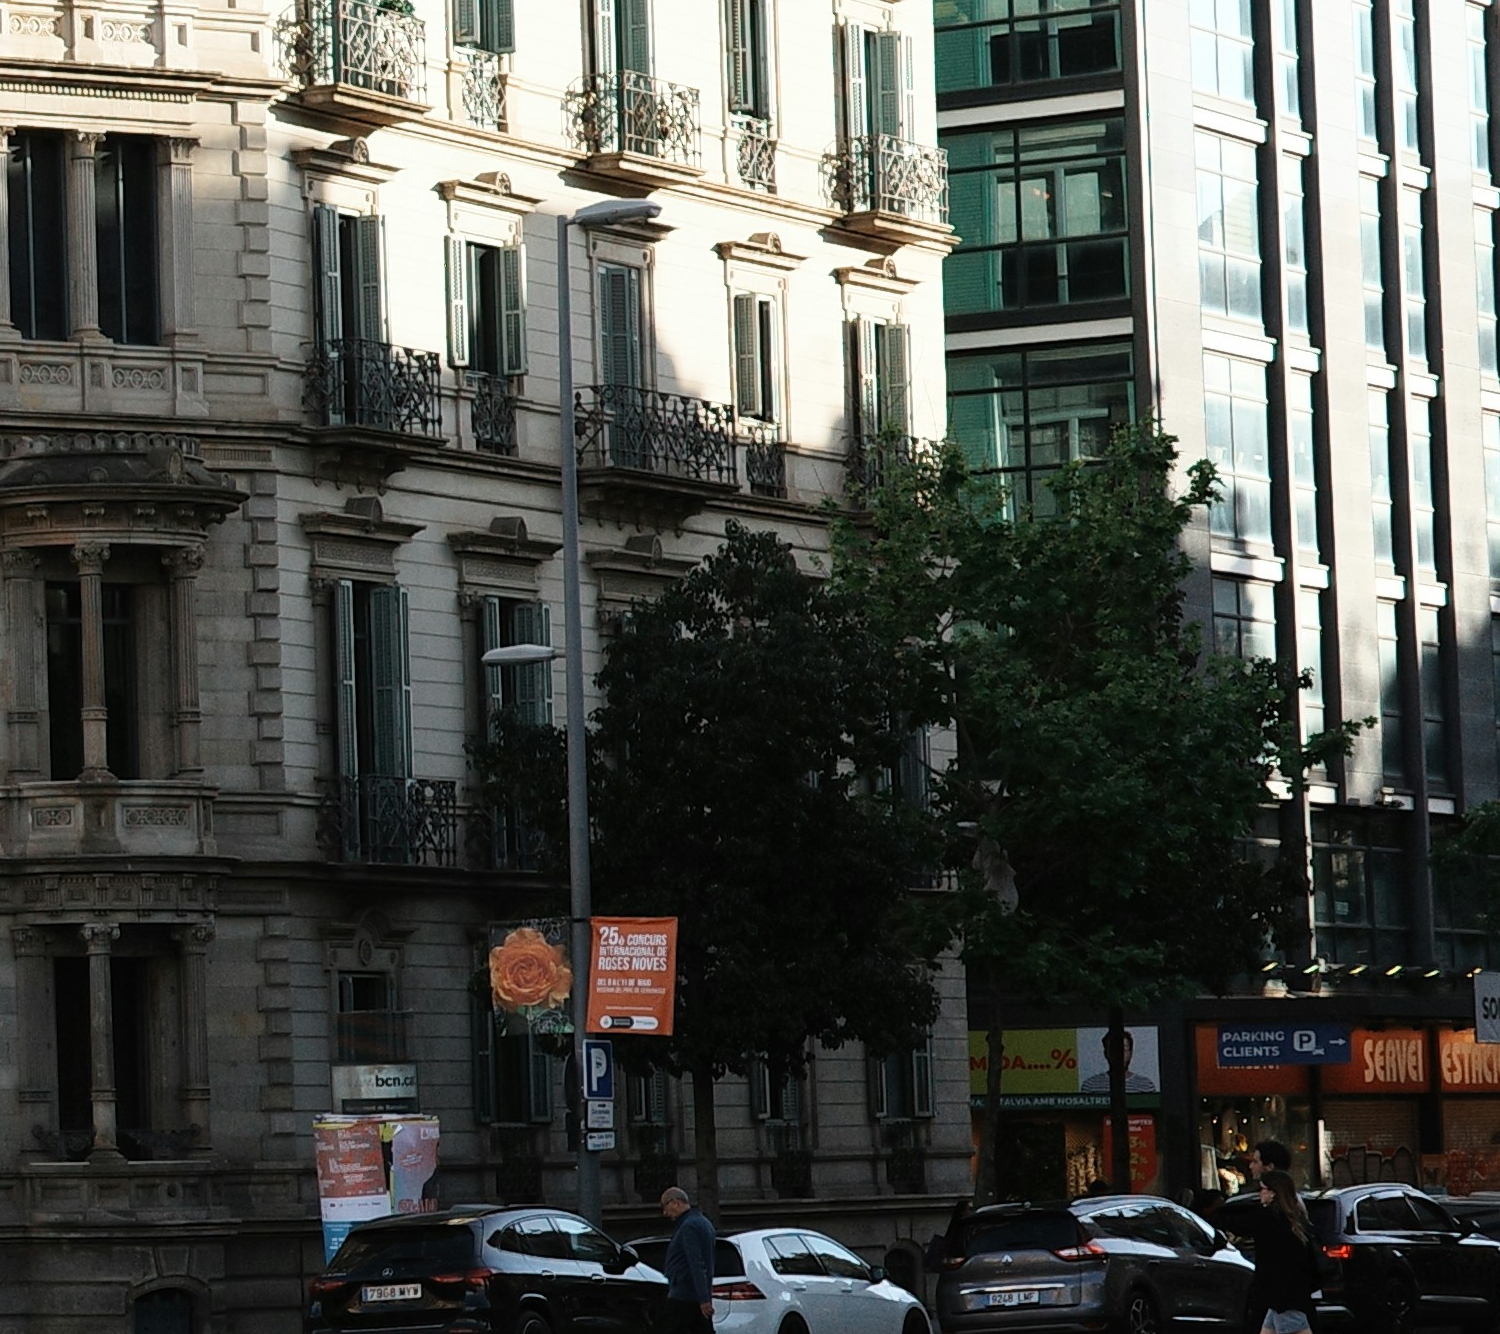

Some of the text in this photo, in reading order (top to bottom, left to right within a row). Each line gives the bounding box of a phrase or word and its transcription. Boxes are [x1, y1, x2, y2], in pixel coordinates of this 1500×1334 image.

[627, 934, 668, 946] CONCURS
[657, 946, 668, 957] DE
[598, 957, 668, 971] ROSES NOVES
[1482, 996, 1500, 1020] SO
[1222, 1031, 1285, 1044] PARKING
[1222, 1045, 1281, 1058] CLIENTS
[1363, 1039, 1424, 1083] SERVEI
